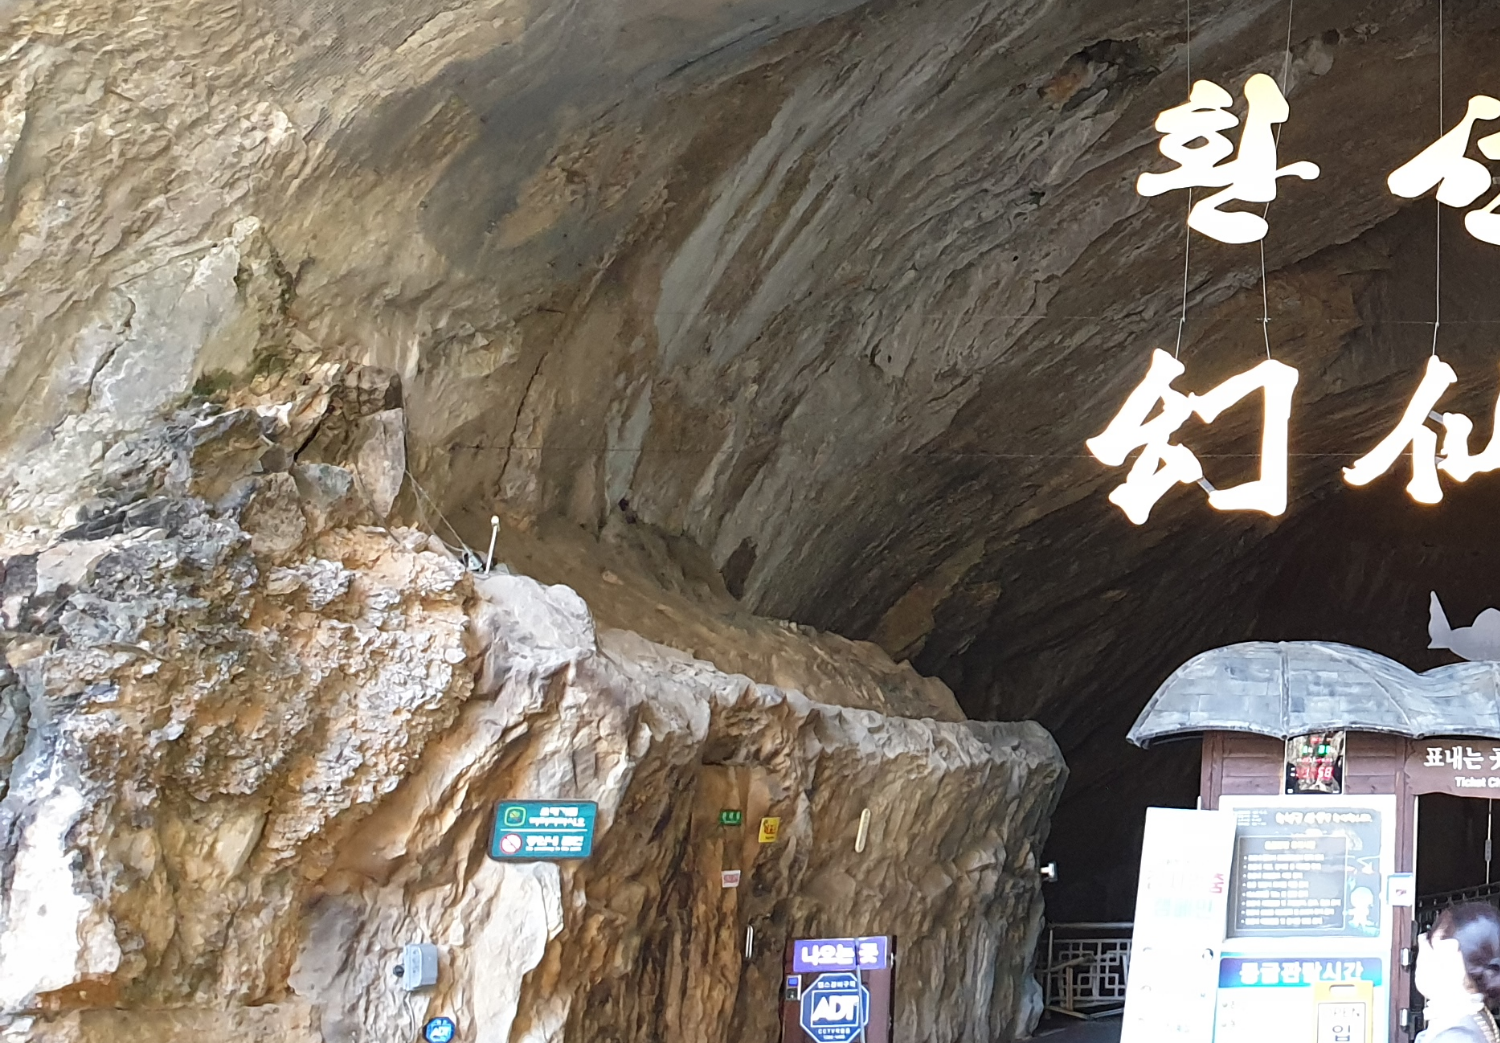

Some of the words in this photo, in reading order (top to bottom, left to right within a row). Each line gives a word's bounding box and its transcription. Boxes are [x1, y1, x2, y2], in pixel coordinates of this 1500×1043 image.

[1424, 746, 1484, 770] 표내는
[1455, 777, 1486, 788] Ticket
[801, 944, 855, 966] 나오는
[859, 943, 879, 964] 곳
[812, 995, 860, 1022] ADT
